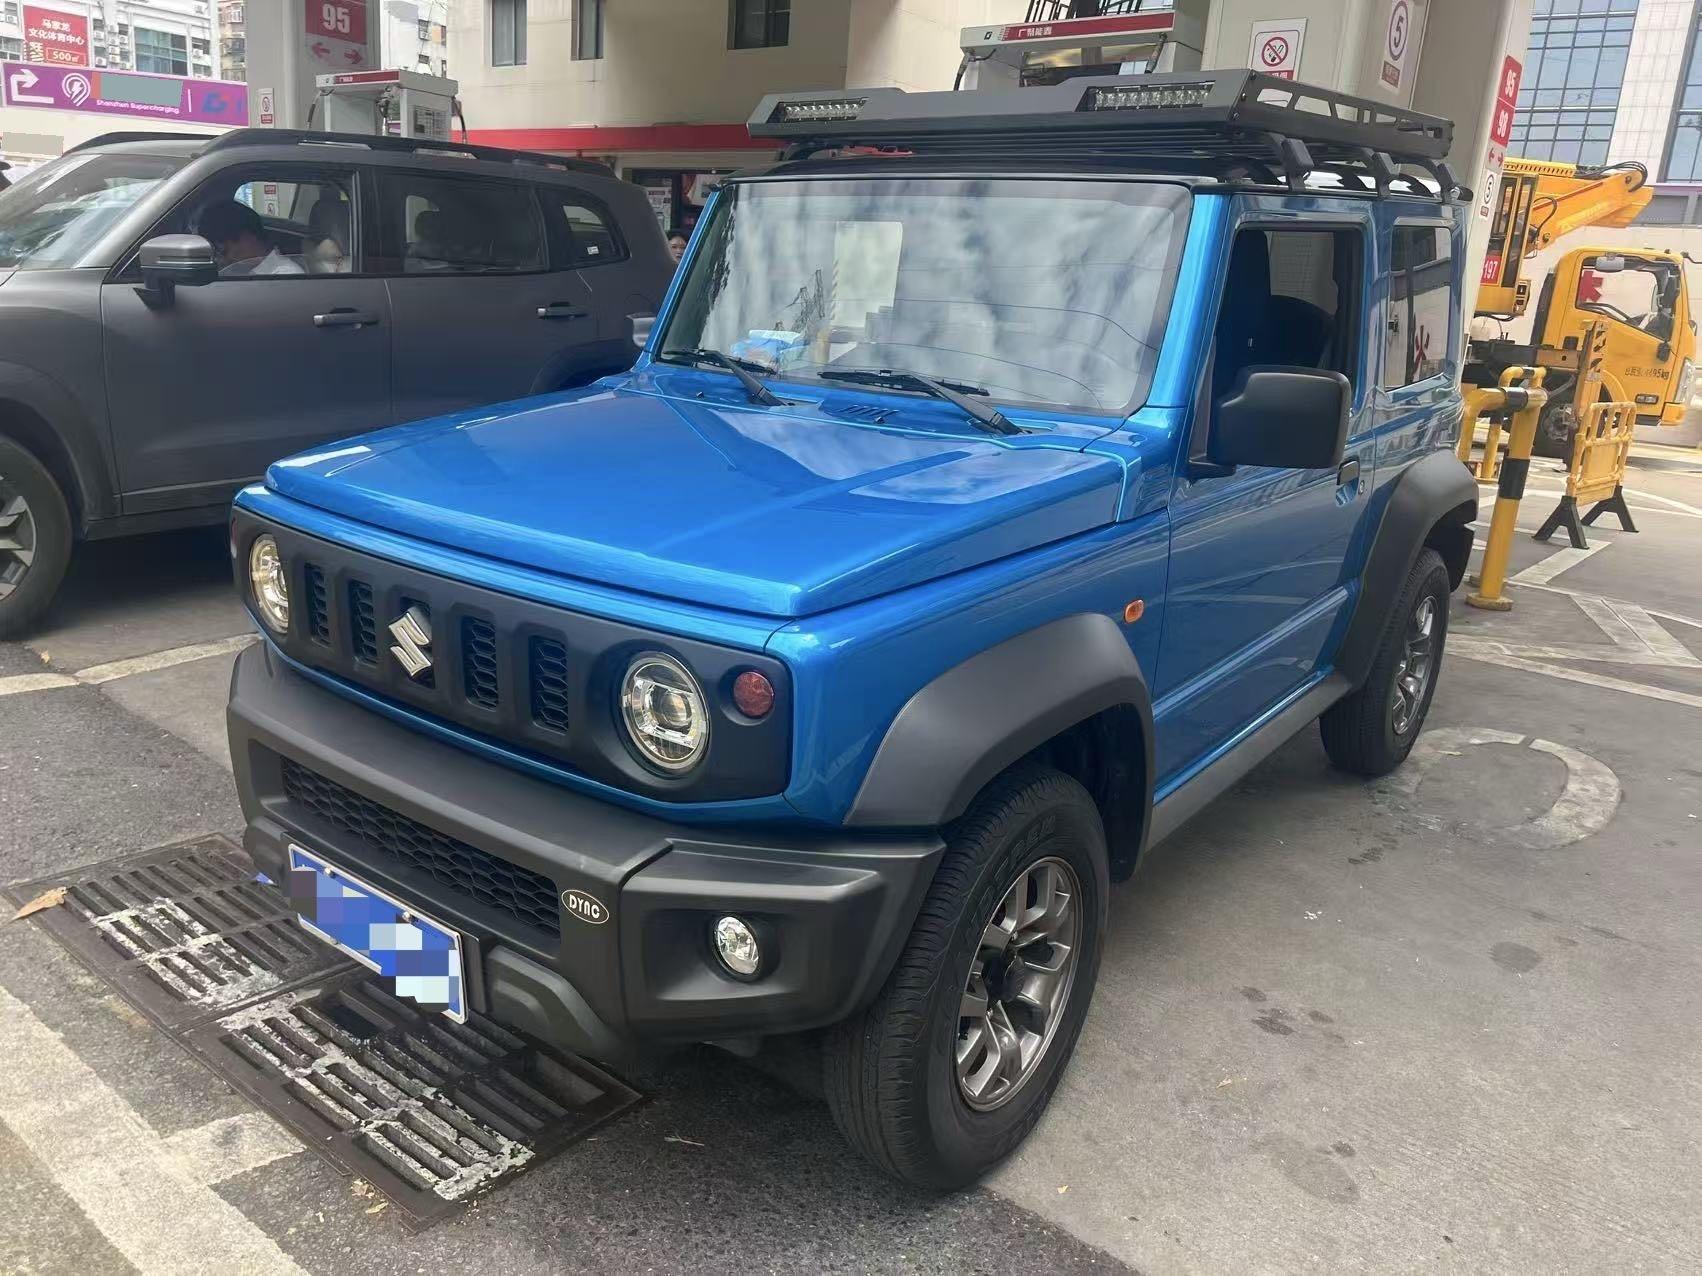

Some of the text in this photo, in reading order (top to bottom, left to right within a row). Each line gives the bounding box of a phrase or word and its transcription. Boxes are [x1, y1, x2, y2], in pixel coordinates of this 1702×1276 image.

[322, 3, 350, 33] 95
[1394, 15, 1404, 48] 5
[28, 27, 85, 46] 文化体育中心
[1504, 69, 1517, 98] 95
[130, 102, 180, 114] Supercharging
